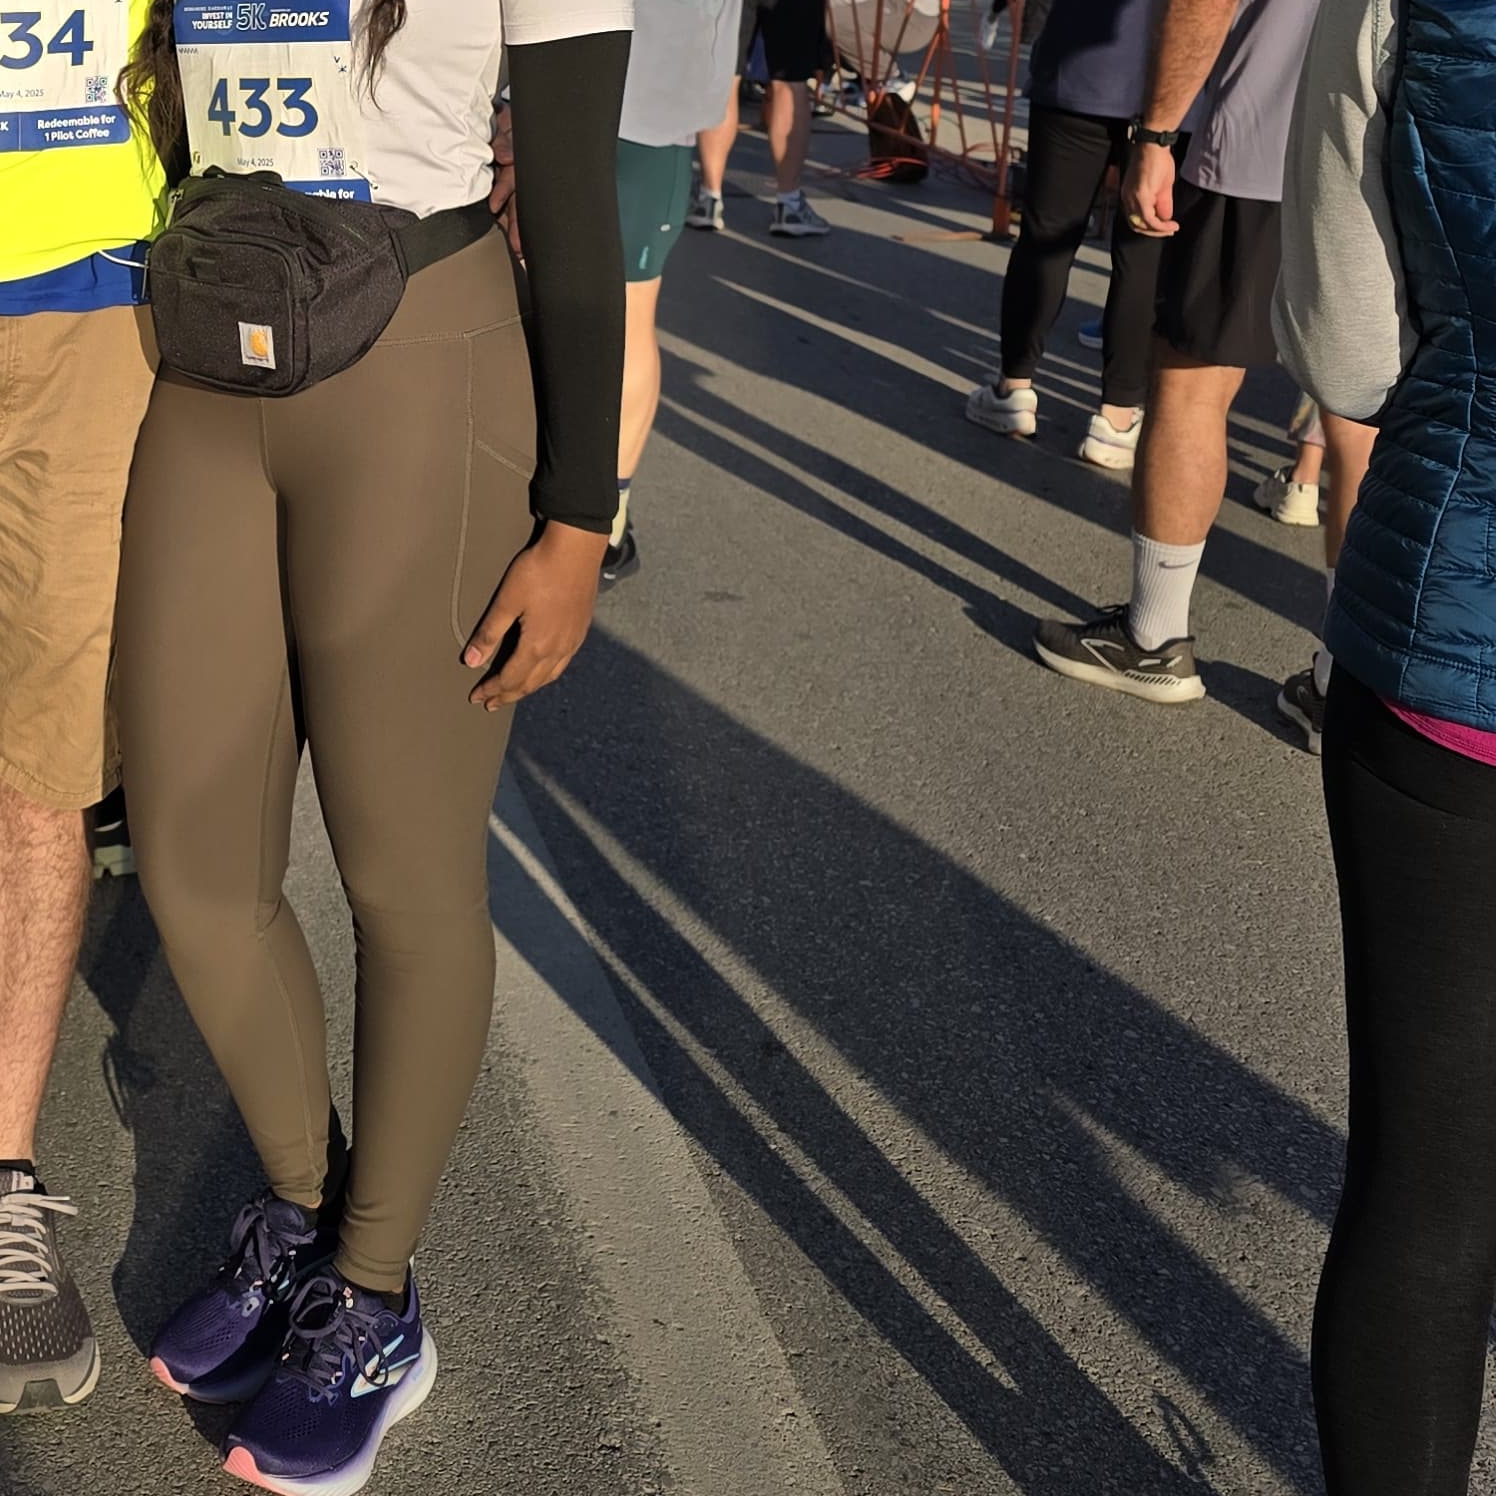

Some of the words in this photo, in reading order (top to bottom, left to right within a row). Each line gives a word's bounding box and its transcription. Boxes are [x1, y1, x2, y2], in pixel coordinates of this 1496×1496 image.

[235, 2, 268, 31] 5K
[269, 11, 330, 28] BROOKS
[191, 19, 233, 30] YOURSELF
[24, 88, 45, 98] 2025
[207, 77, 319, 138] 433
[37, 116, 100, 130] Redeemable
[100, 114, 117, 125] for
[51, 130, 74, 142] Pilot
[75, 128, 110, 140] Coffee
[257, 157, 274, 168] 2025
[338, 189, 355, 199] for
